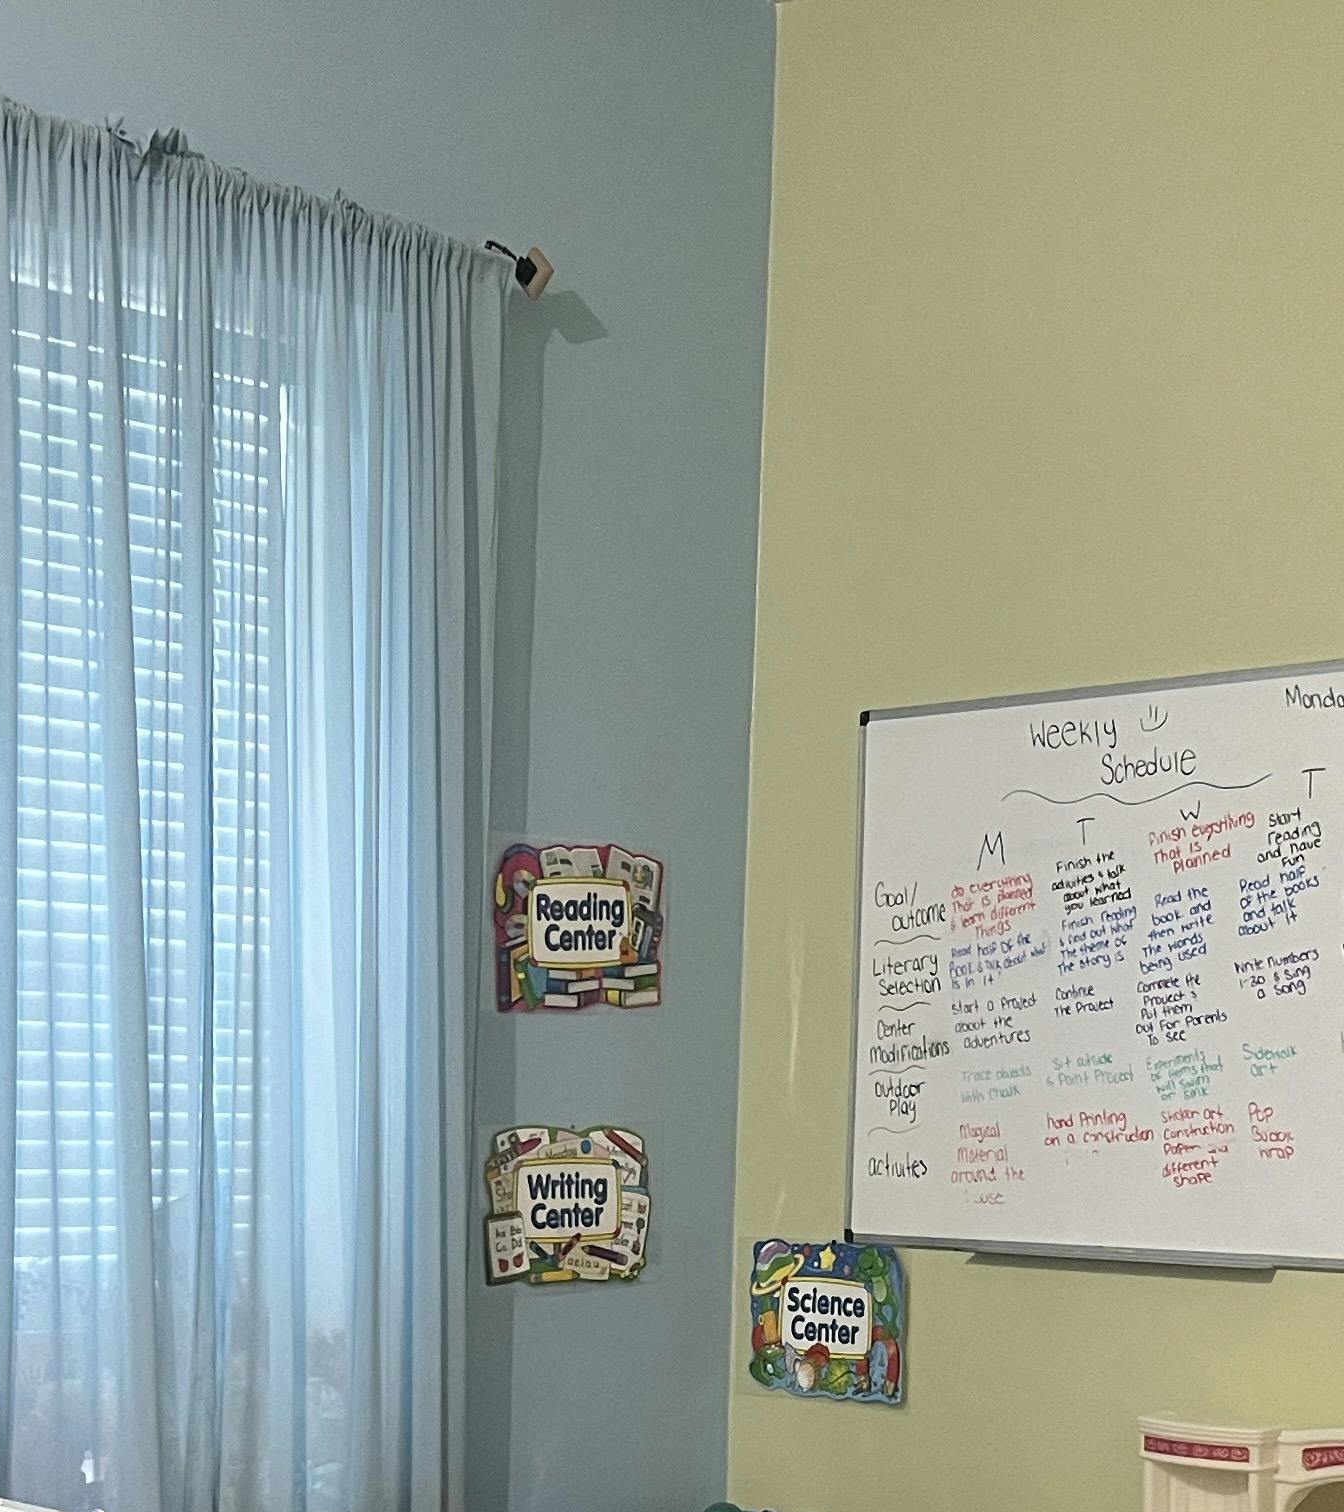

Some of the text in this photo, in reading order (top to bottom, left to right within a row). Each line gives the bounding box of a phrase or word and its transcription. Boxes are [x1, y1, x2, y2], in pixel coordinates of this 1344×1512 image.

[1031, 720, 1118, 748] Weekly
[1101, 746, 1196, 785] Schedule
[1302, 768, 1326, 798] T
[1180, 800, 1200, 822] W
[1076, 817, 1094, 844] T
[1268, 822, 1321, 845] reading
[977, 831, 1005, 870] M
[1097, 851, 1114, 864] the
[1258, 846, 1281, 863] and
[1239, 874, 1269, 892] Read
[1257, 876, 1319, 904] the books
[1065, 902, 1084, 915] you
[1155, 888, 1208, 908] Read the
[536, 892, 624, 927] Reading
[1152, 900, 1211, 926] book and
[1243, 898, 1296, 922] and talk
[545, 924, 616, 951] Center
[1090, 925, 1106, 938] out
[1148, 928, 1174, 941] then
[1238, 917, 1275, 936] about
[873, 954, 938, 976] Literary
[1080, 955, 1111, 969] story
[1139, 943, 1206, 974] being used
[1267, 949, 1319, 968] numbers
[1163, 1004, 1192, 1018] them
[877, 1020, 915, 1040] Center
[964, 1030, 1030, 1048] adventures
[1067, 1134, 1075, 1143] a
[527, 1172, 608, 1205] Writing
[531, 1203, 604, 1229] Center
[787, 1287, 865, 1318] Science
[791, 1315, 859, 1345] Center
